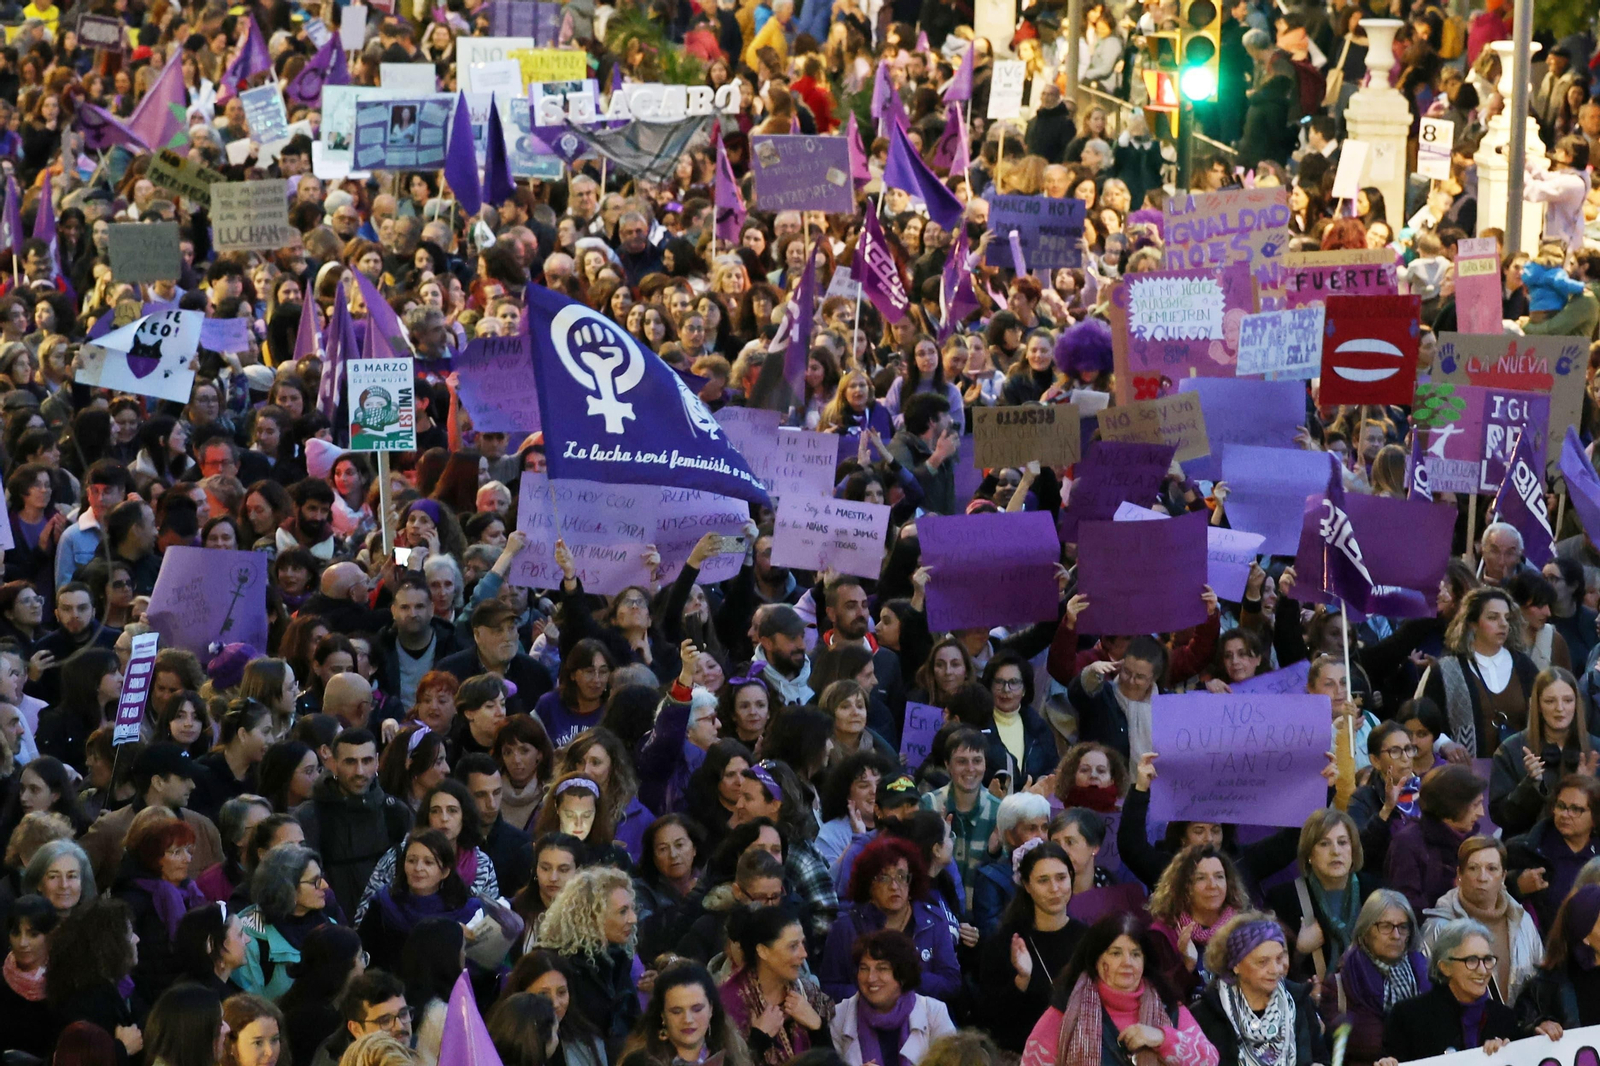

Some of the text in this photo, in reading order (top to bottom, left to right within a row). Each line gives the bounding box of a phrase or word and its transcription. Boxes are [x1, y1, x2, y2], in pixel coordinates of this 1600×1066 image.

[541, 78, 742, 124] SE ACABÓ
[1422, 124, 1437, 142] 8
[1048, 201, 1076, 217] HOY
[1169, 194, 1197, 216] LA
[218, 224, 280, 244] LUCHAN
[1295, 268, 1387, 292] FUERTE
[165, 310, 183, 324] TE
[1140, 308, 1211, 324] DEMUESTREN
[353, 362, 408, 373] 8 MARZO
[1467, 355, 1550, 374] LA NUEVA
[398, 387, 414, 449] PALESTINA
[996, 408, 1055, 425] RESPETO
[1105, 412, 1131, 430] NO
[1138, 405, 1167, 422] SOY
[372, 440, 401, 450] FREE
[562, 440, 588, 460] La
[588, 443, 633, 462] lucha
[634, 450, 669, 465] será
[669, 449, 733, 475] feminista
[527, 482, 636, 508] VENGO HOY CON
[804, 502, 819, 518] Soy
[835, 507, 873, 522] MAESTRA
[527, 513, 553, 529] MIS
[617, 520, 646, 540] PARA
[805, 521, 829, 534] NIÑAS
[852, 527, 879, 541] JAMÁS
[520, 560, 549, 580] POR
[909, 706, 928, 732] En
[1221, 702, 1266, 725] NOS
[1175, 724, 1316, 752] QUITARON
[906, 742, 927, 758] me
[1206, 750, 1294, 773] TANTO
